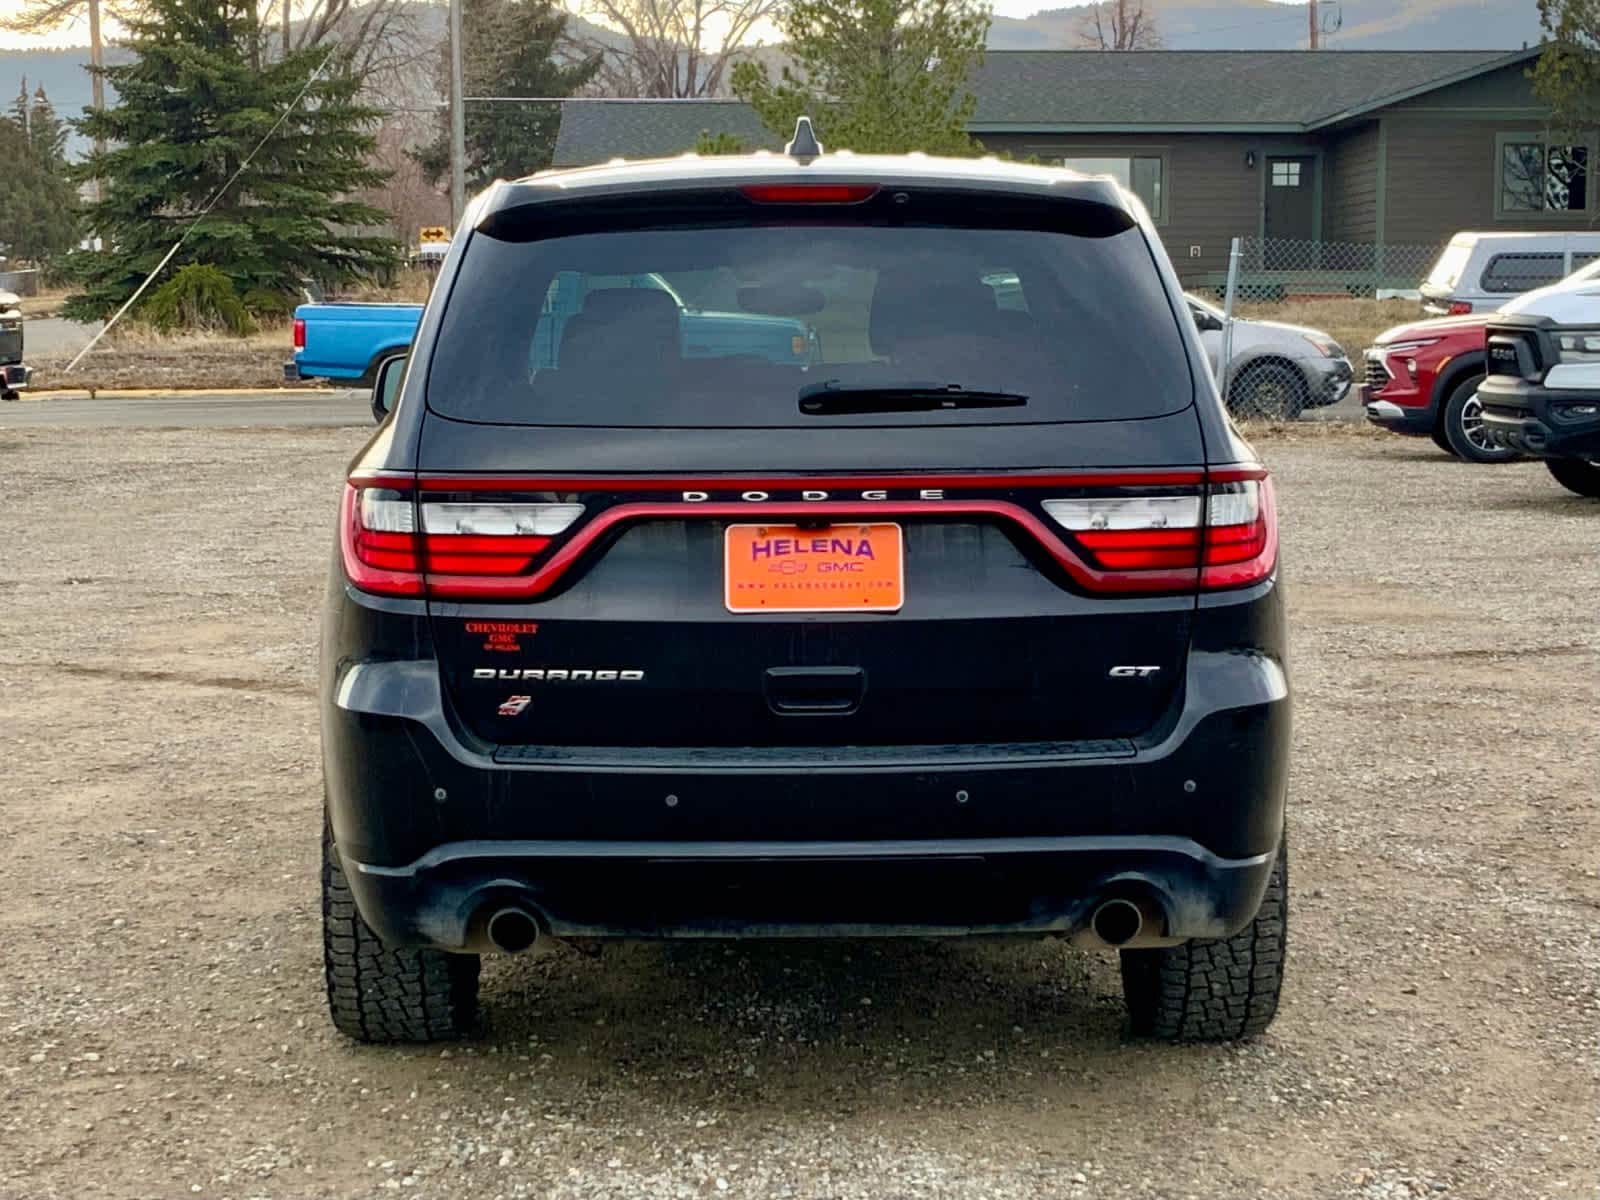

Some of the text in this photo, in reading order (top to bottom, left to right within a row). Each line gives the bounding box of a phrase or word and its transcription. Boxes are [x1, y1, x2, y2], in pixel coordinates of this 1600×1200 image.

[682, 489, 944, 502] DODGE
[752, 538, 875, 562] HELENA
[817, 561, 865, 572] GMC
[465, 622, 538, 633] CHEVROLET
[489, 633, 515, 643] GMC
[473, 668, 645, 681] DURANGO
[1108, 665, 1161, 677] GT
